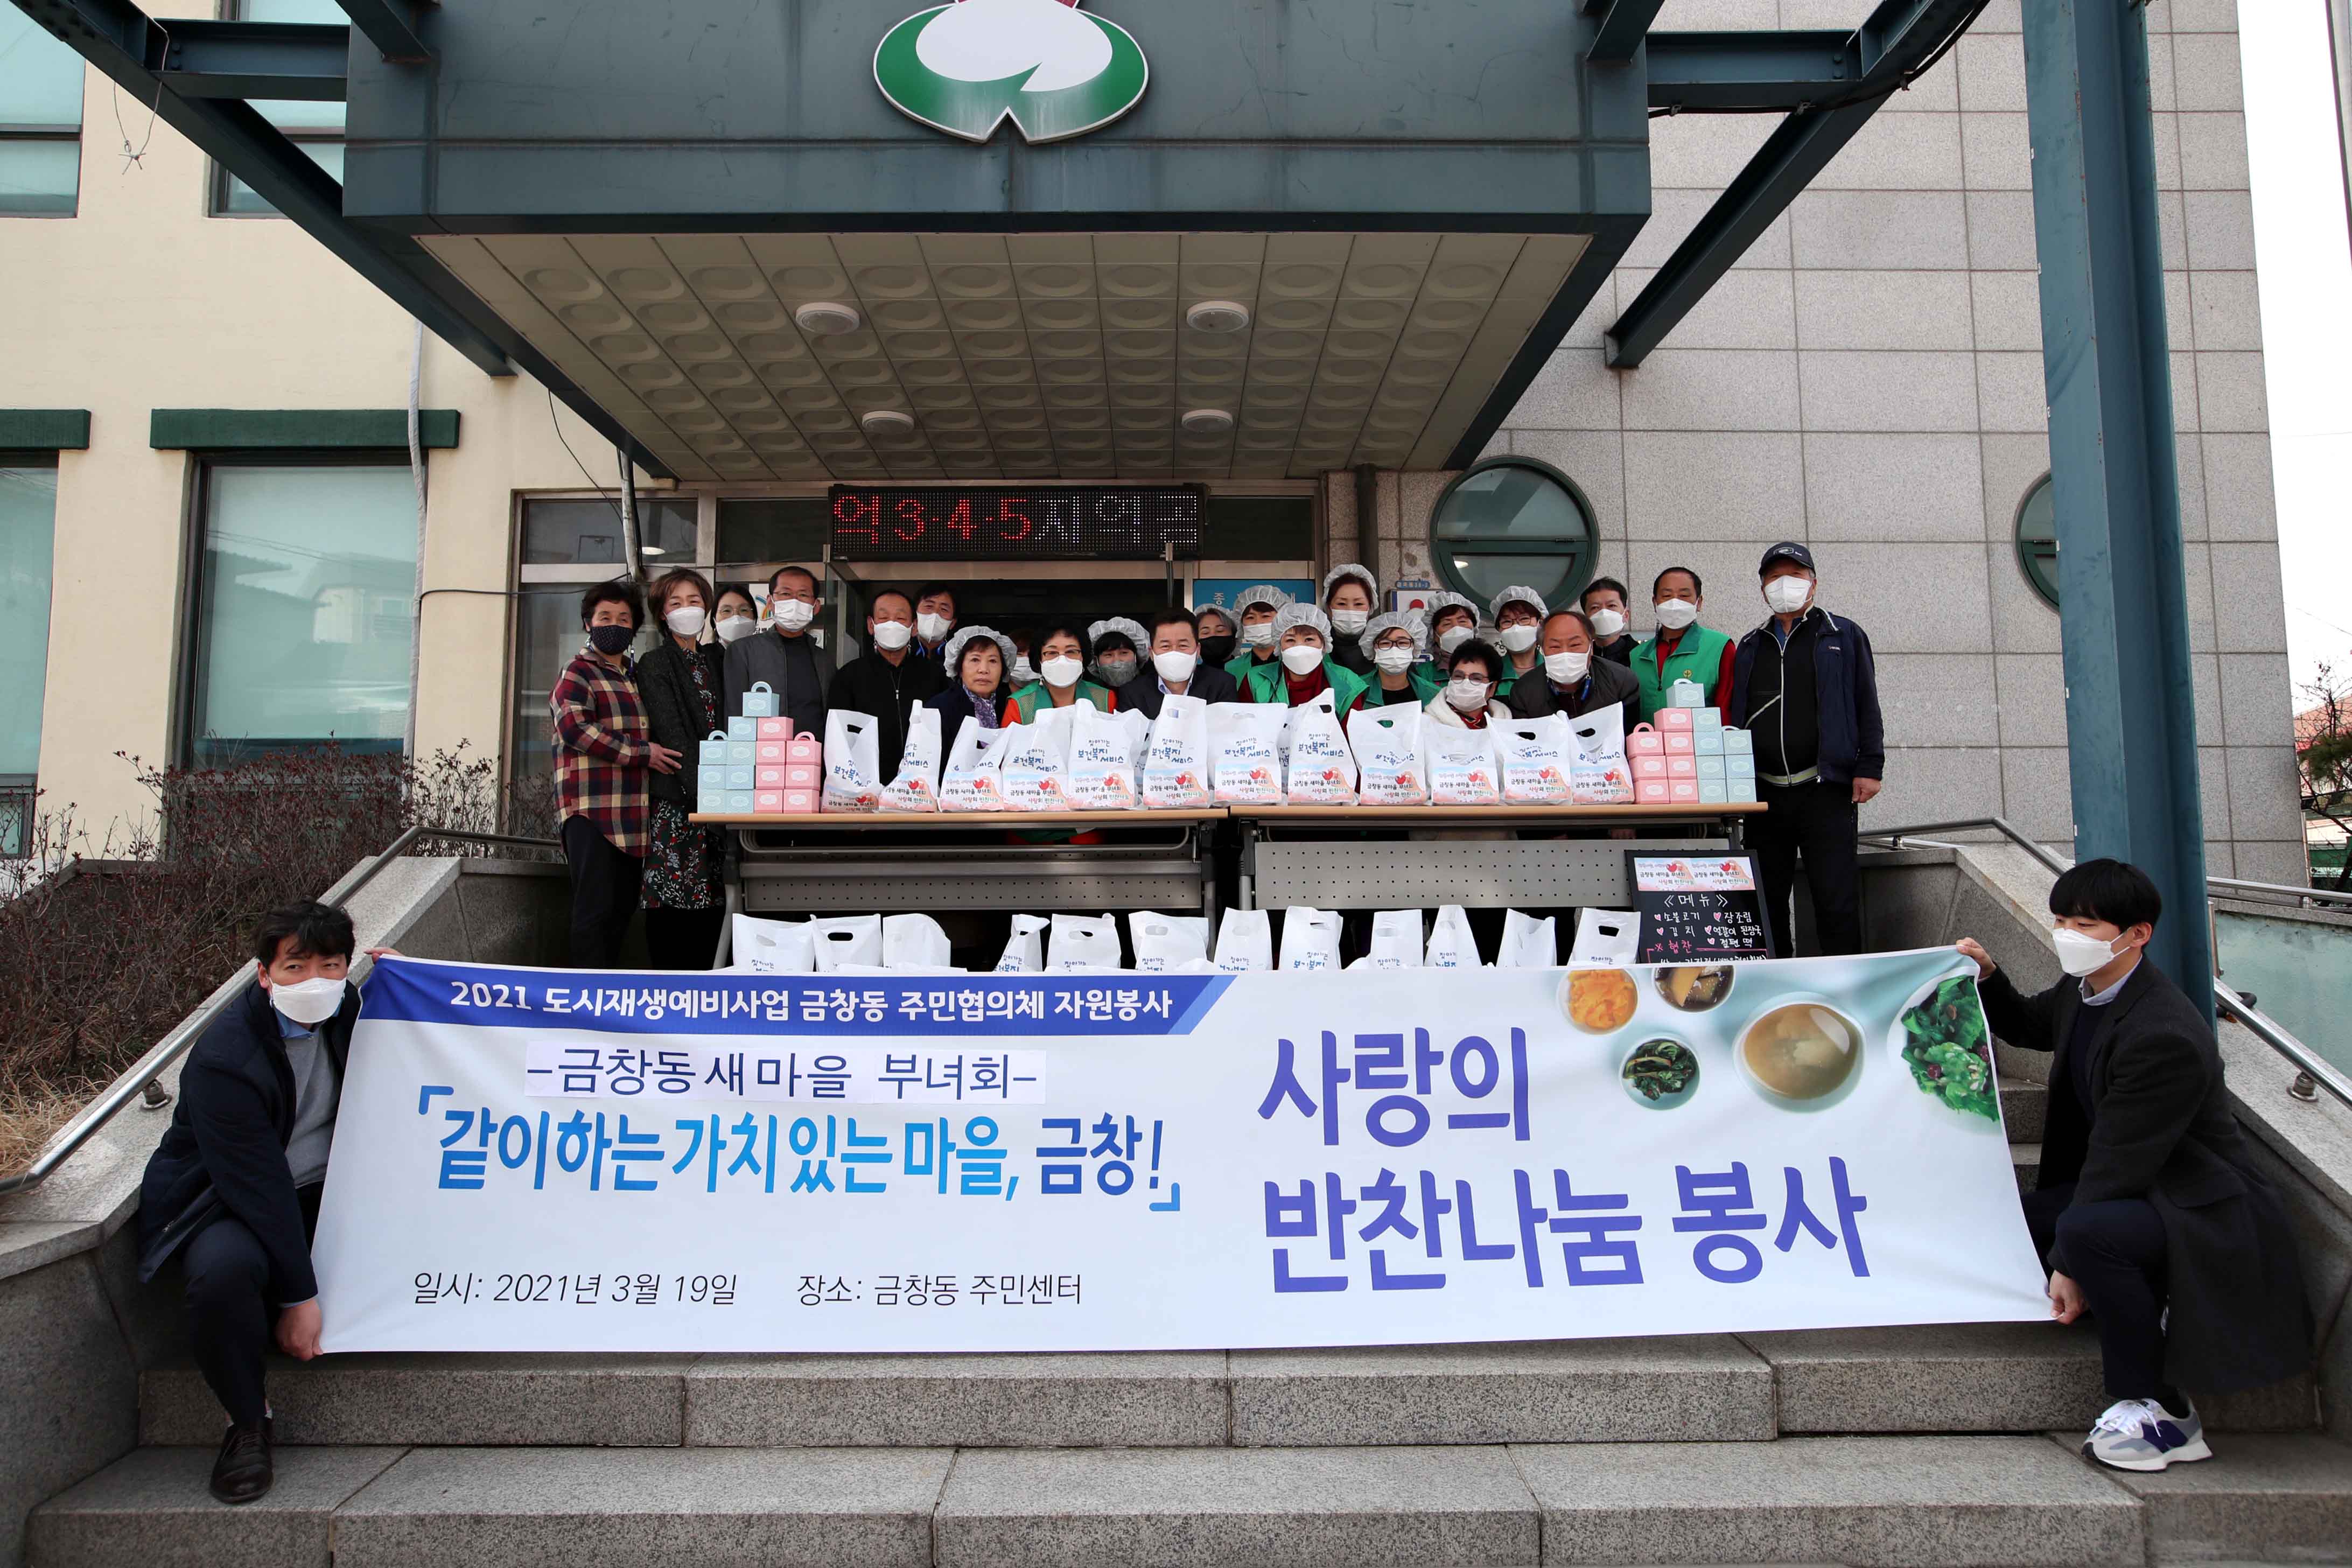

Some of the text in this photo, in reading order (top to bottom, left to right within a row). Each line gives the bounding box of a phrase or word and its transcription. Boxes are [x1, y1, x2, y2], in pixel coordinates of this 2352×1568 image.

[1152, 747, 1181, 759] 보건복지
[1224, 745, 1255, 757] 보건복지
[1248, 749, 1271, 758] 서비스
[1299, 741, 1328, 754] 보건복지
[1320, 749, 1344, 757] 서비스
[1078, 748, 1108, 761] 보건복지
[1724, 912, 1752, 924] 장조림
[1713, 925, 1761, 937] 얼갈이 된장국
[451, 982, 1173, 1021] 2021 도시재생예비사업 금창동 주민협의체 자원봉사
[1257, 1026, 1530, 1147] 사랑의
[1264, 1156, 1871, 1293] 반찬나눔 봉사
[414, 1272, 737, 1305] 일시: 2021년 3월 19일
[796, 1274, 1082, 1306] 장소: 금창동 주민센터
